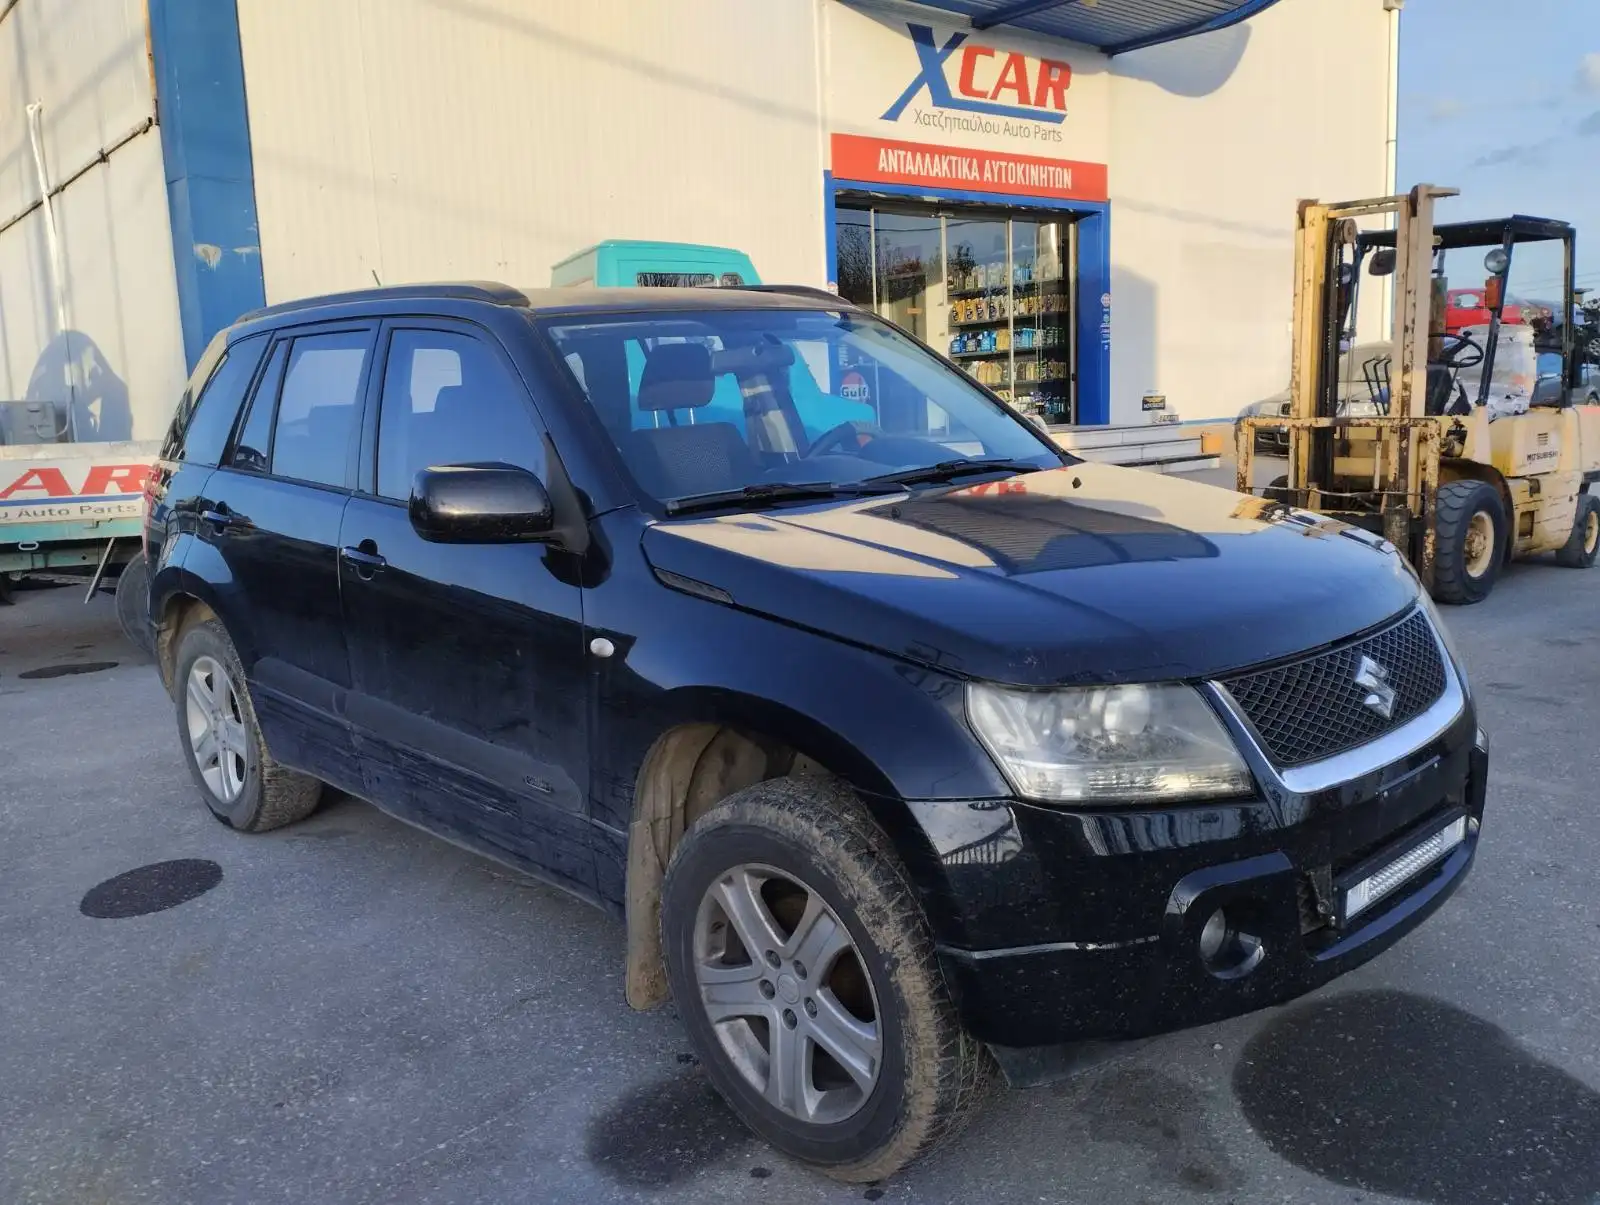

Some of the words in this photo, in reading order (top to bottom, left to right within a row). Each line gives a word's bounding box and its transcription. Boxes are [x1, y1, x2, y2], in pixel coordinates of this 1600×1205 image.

[879, 22, 1072, 122] XCAR
[914, 108, 1000, 134] Χατζηπαύλου
[1003, 124, 1031, 138] Auto
[1034, 126, 1062, 142] Parts
[878, 148, 980, 181] ΑΝΤΑΛΛΑΚΤΙΚΑ
[983, 160, 1072, 190] ΑΥΤΟΚΙΝΗΤΩΝ
[842, 386, 868, 397] Gulf
[17, 507, 70, 519] Auto
[79, 503, 137, 515] Parts
